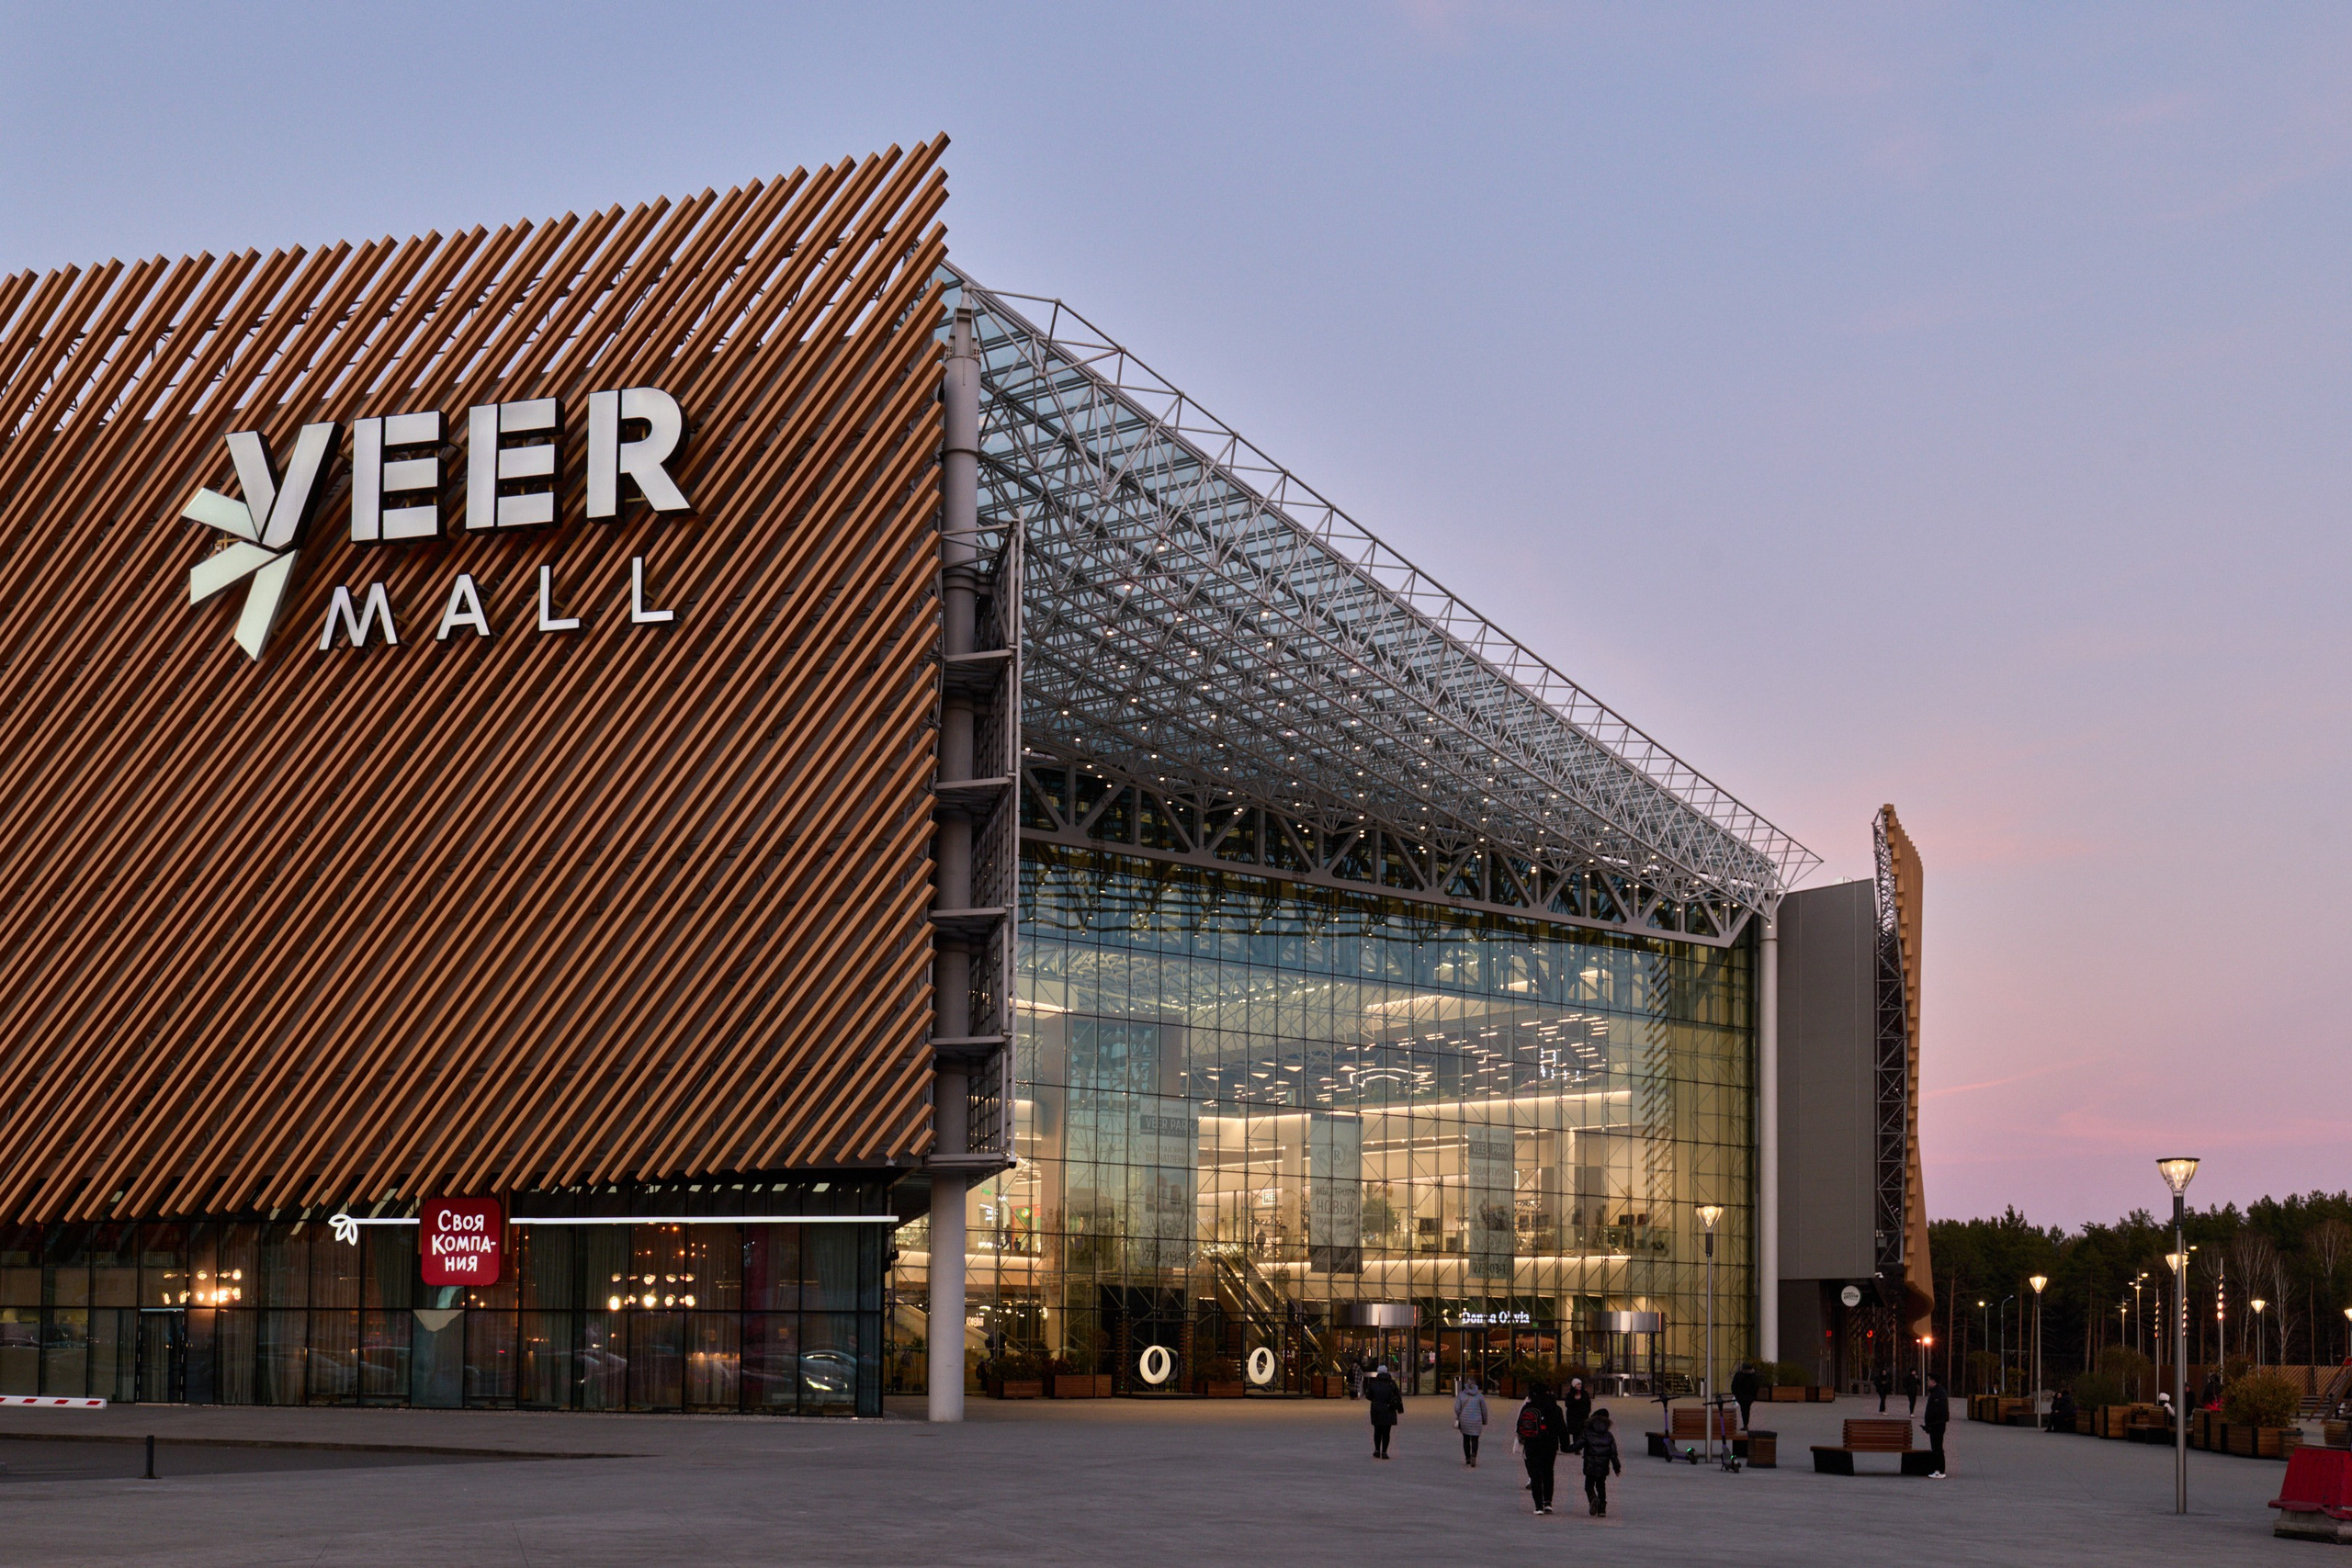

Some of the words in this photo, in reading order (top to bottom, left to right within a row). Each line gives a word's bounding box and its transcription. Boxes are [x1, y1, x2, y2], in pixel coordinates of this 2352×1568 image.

[223, 386, 695, 551] VEER
[318, 556, 675, 651] MALL
[1473, 1142, 1487, 1154] VEE
